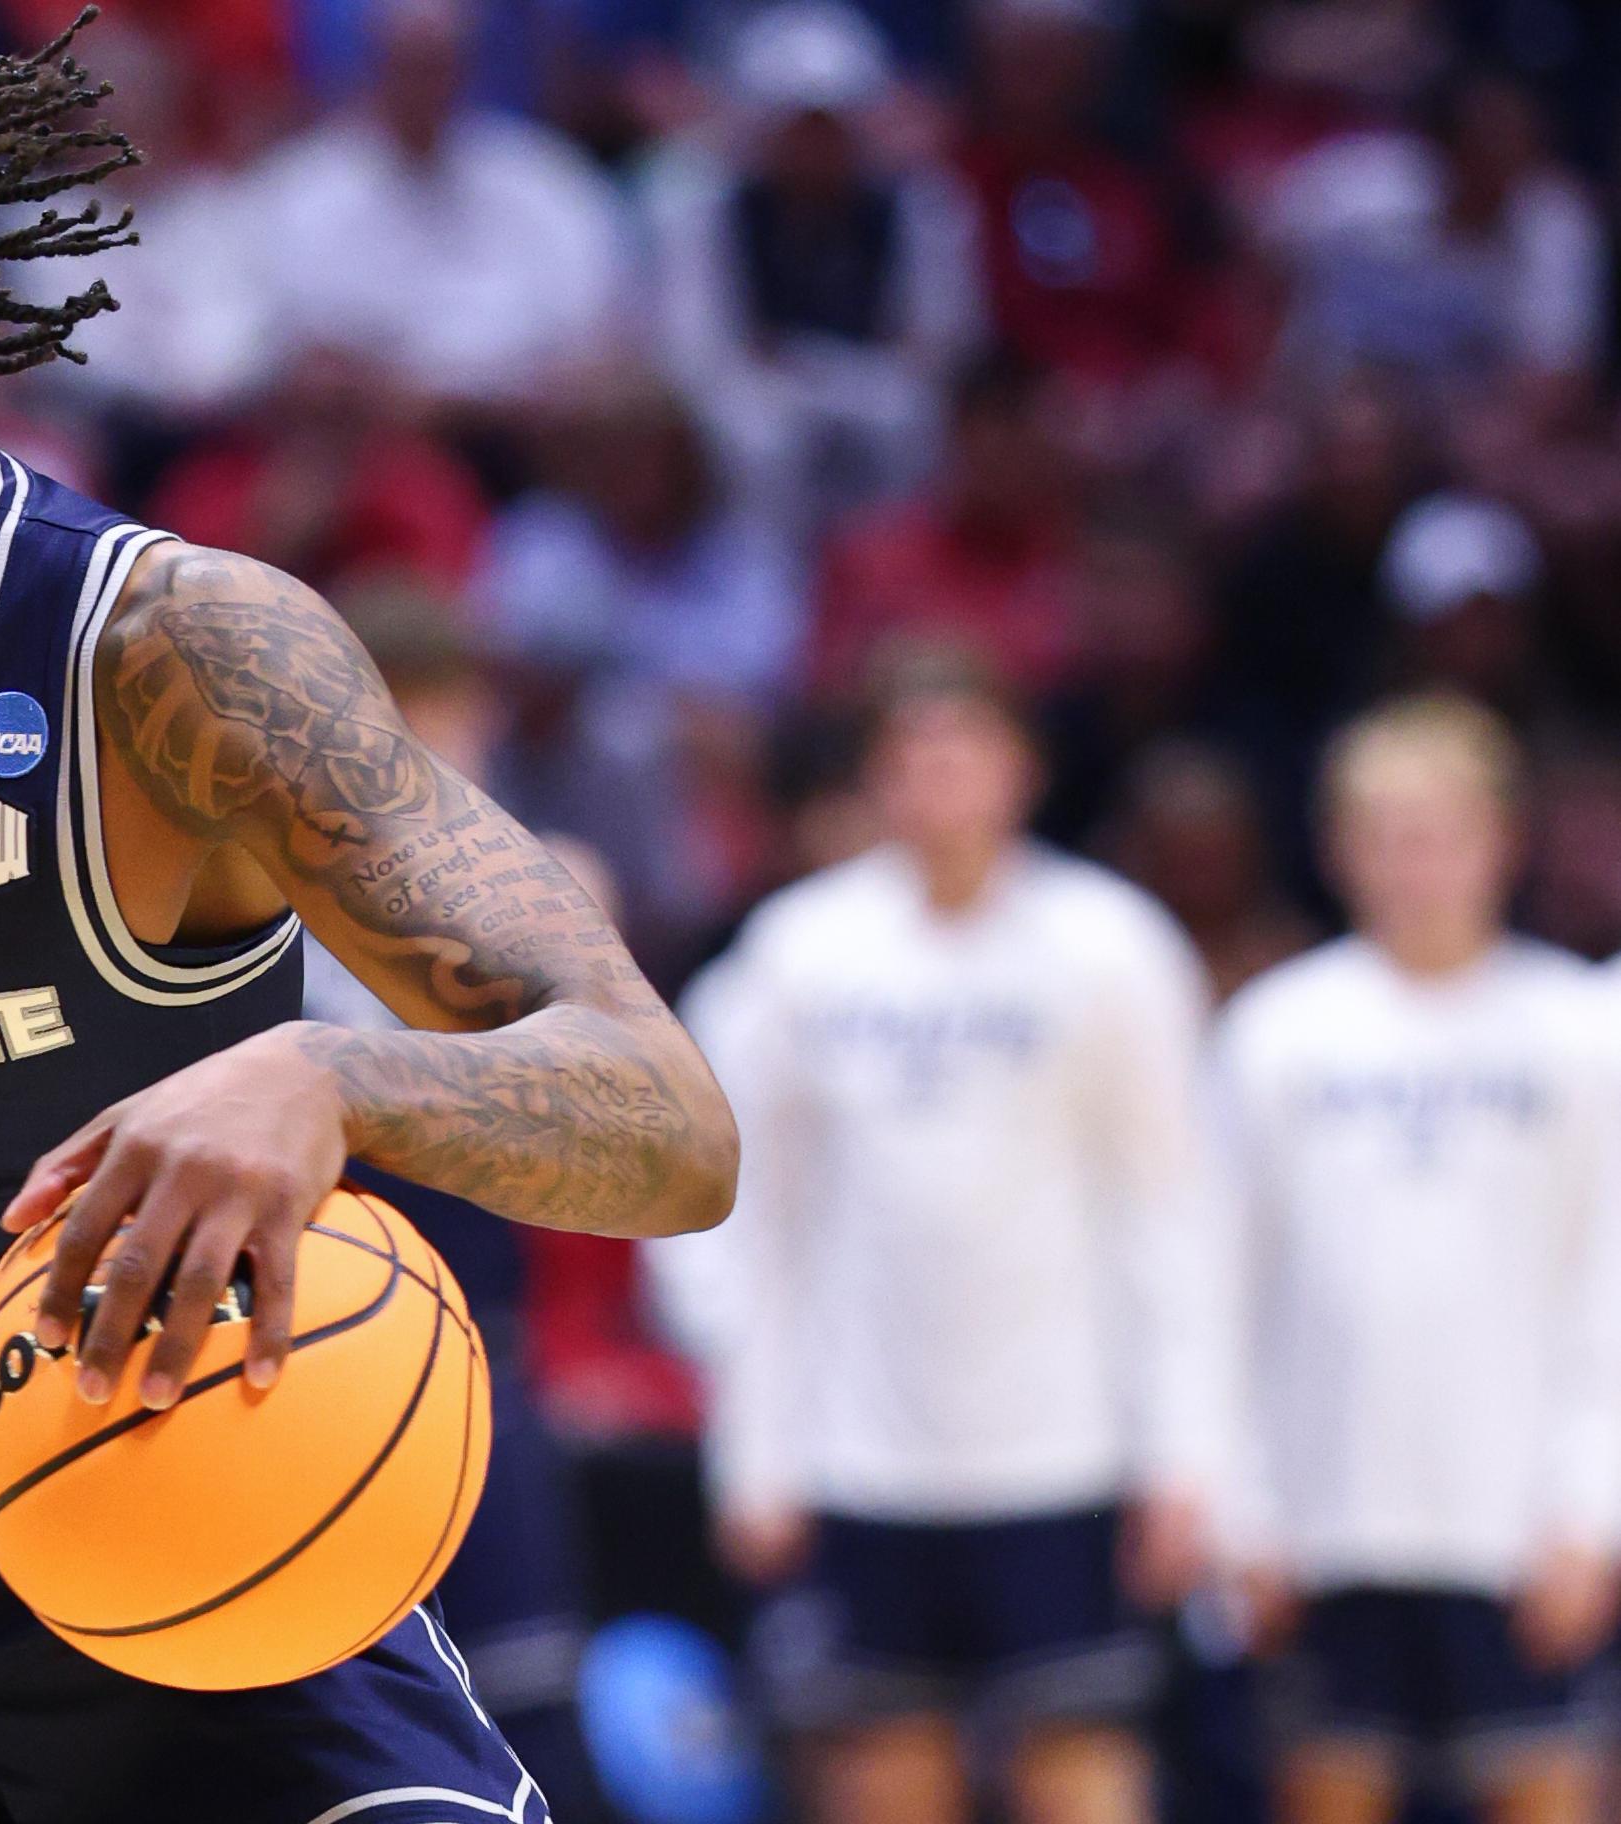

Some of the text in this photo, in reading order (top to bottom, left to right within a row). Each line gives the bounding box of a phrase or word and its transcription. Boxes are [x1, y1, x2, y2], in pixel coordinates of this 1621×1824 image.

[352, 843, 416, 895] Now
[387, 878, 413, 914] of
[443, 885, 481, 918] see
